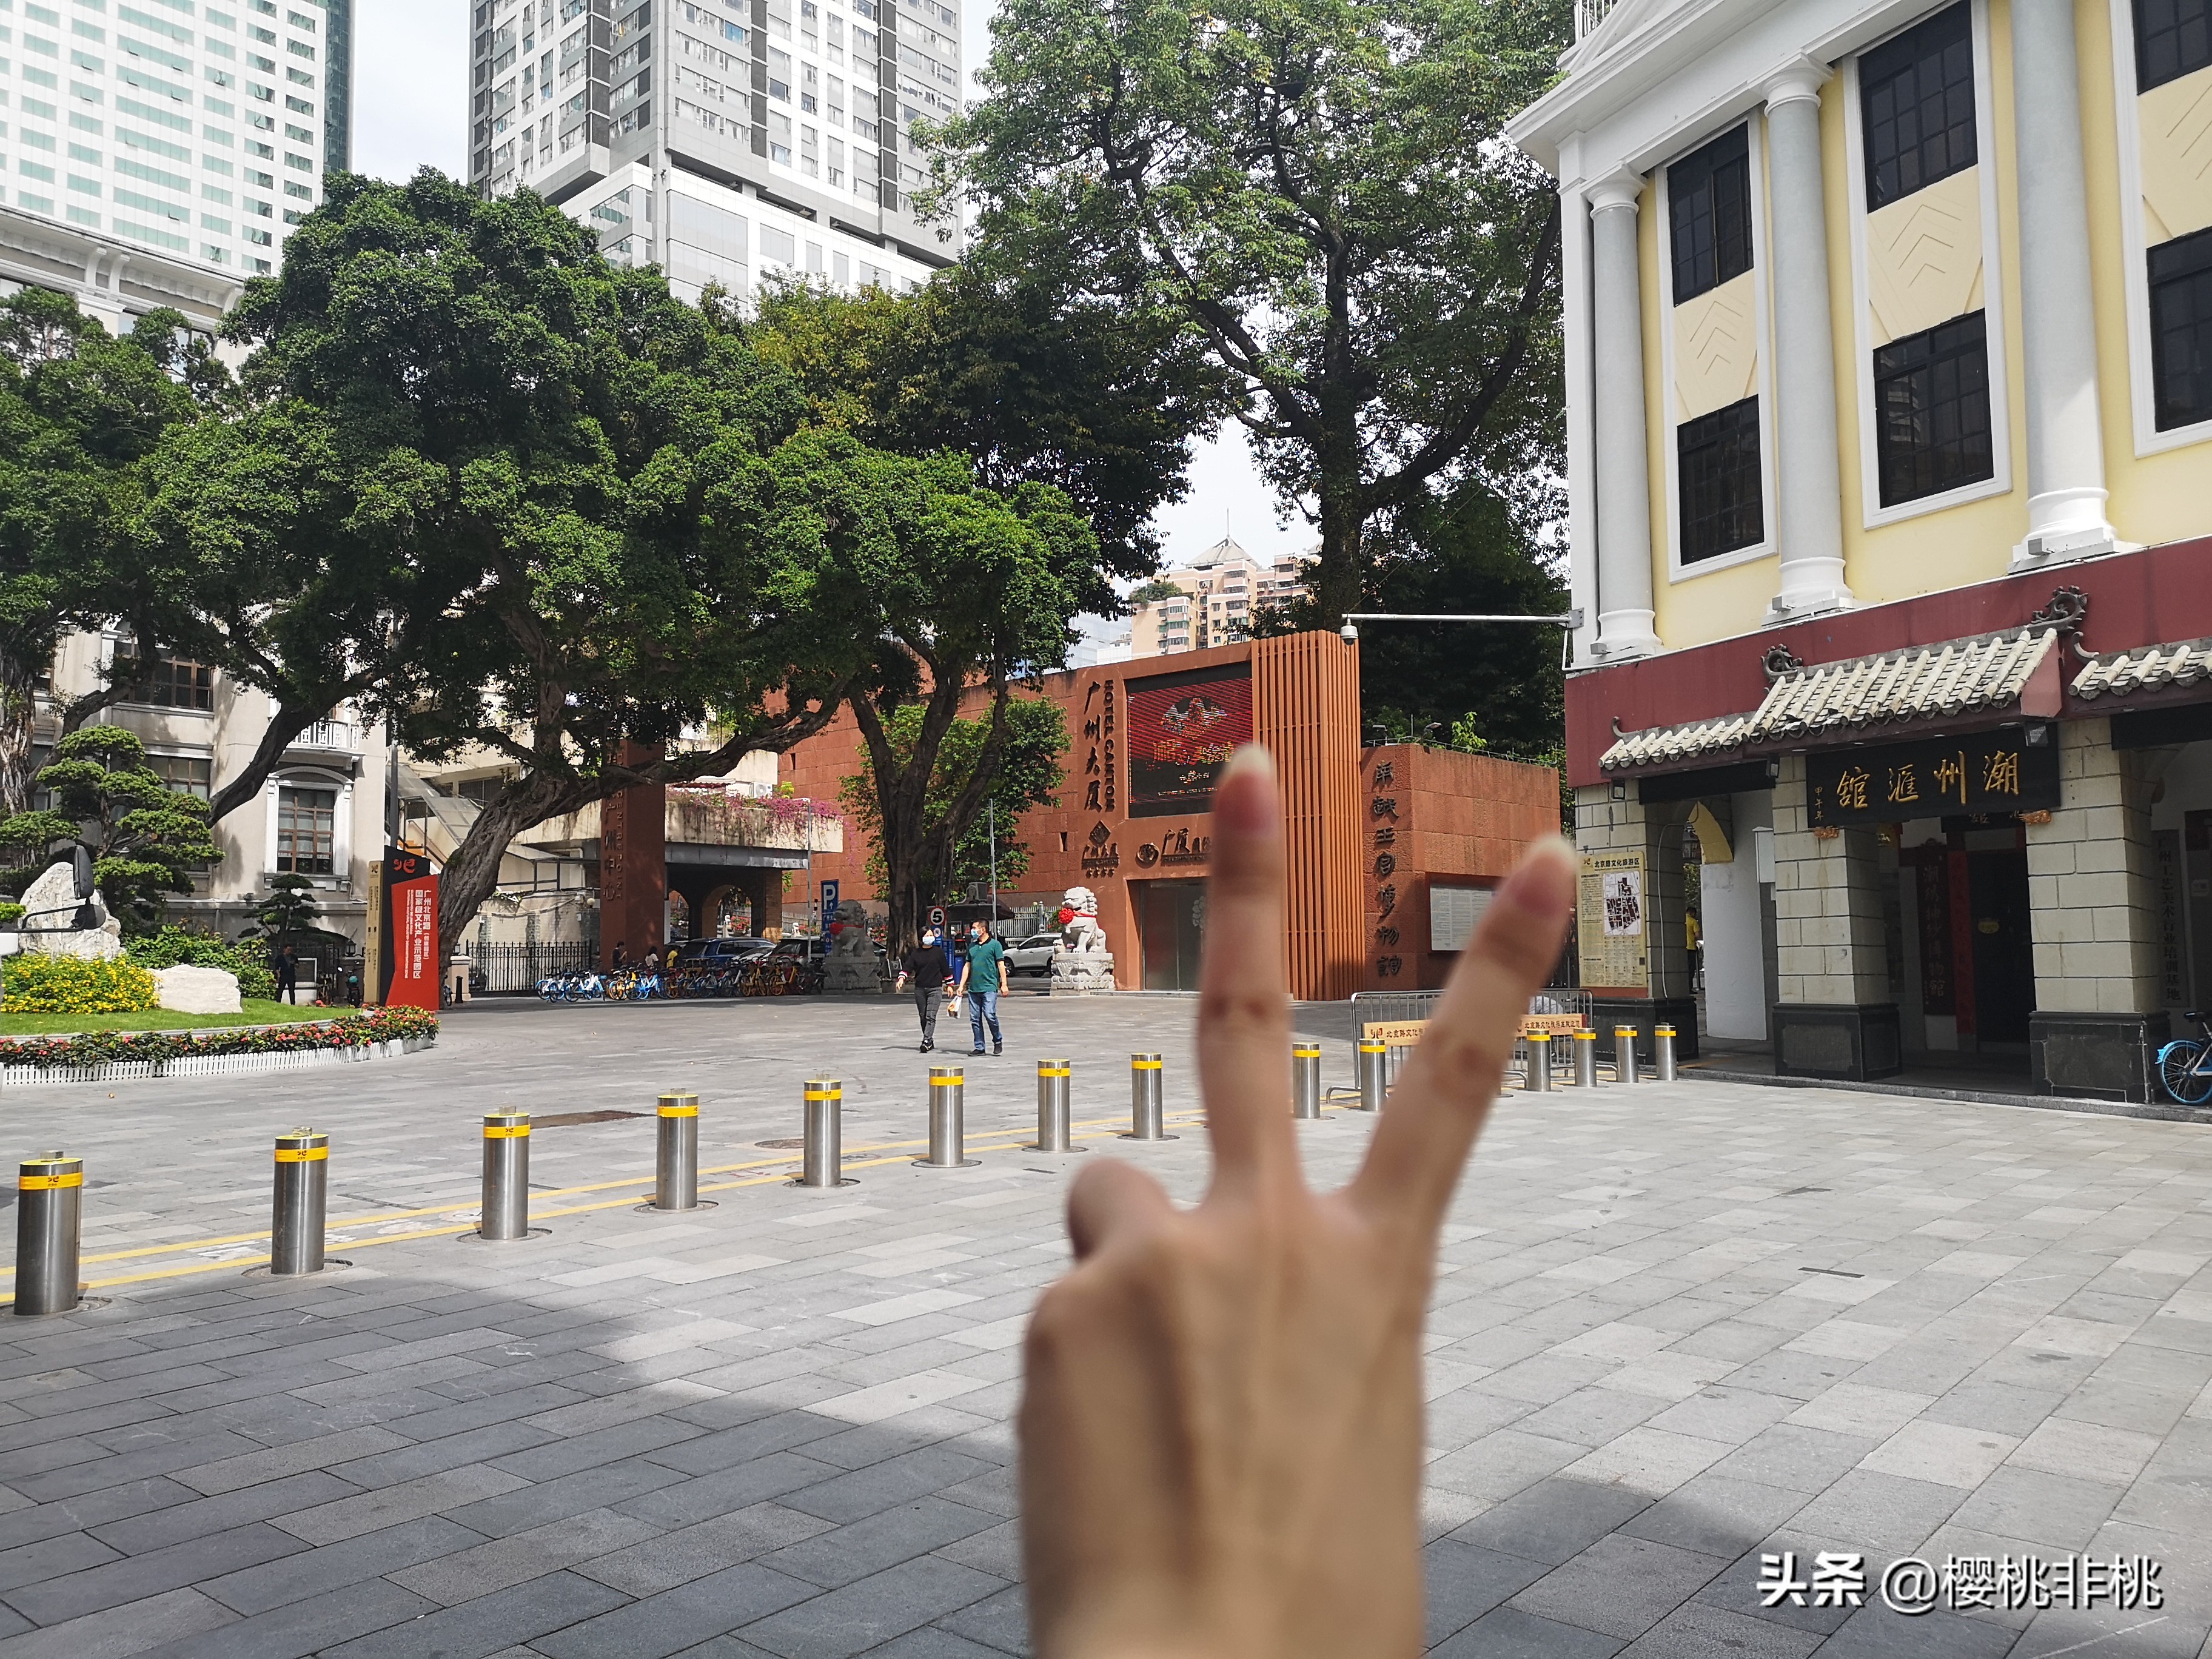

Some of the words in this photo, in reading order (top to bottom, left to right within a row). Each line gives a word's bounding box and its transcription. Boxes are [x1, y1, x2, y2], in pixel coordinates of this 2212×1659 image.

[1104, 680, 1114, 739] HOTEL
[1084, 681, 1102, 813] 广州大厦
[1104, 739, 1115, 813] CANTON
[1814, 786, 1824, 820] 甲午年
[823, 884, 836, 910] P
[933, 911, 942, 923] 5
